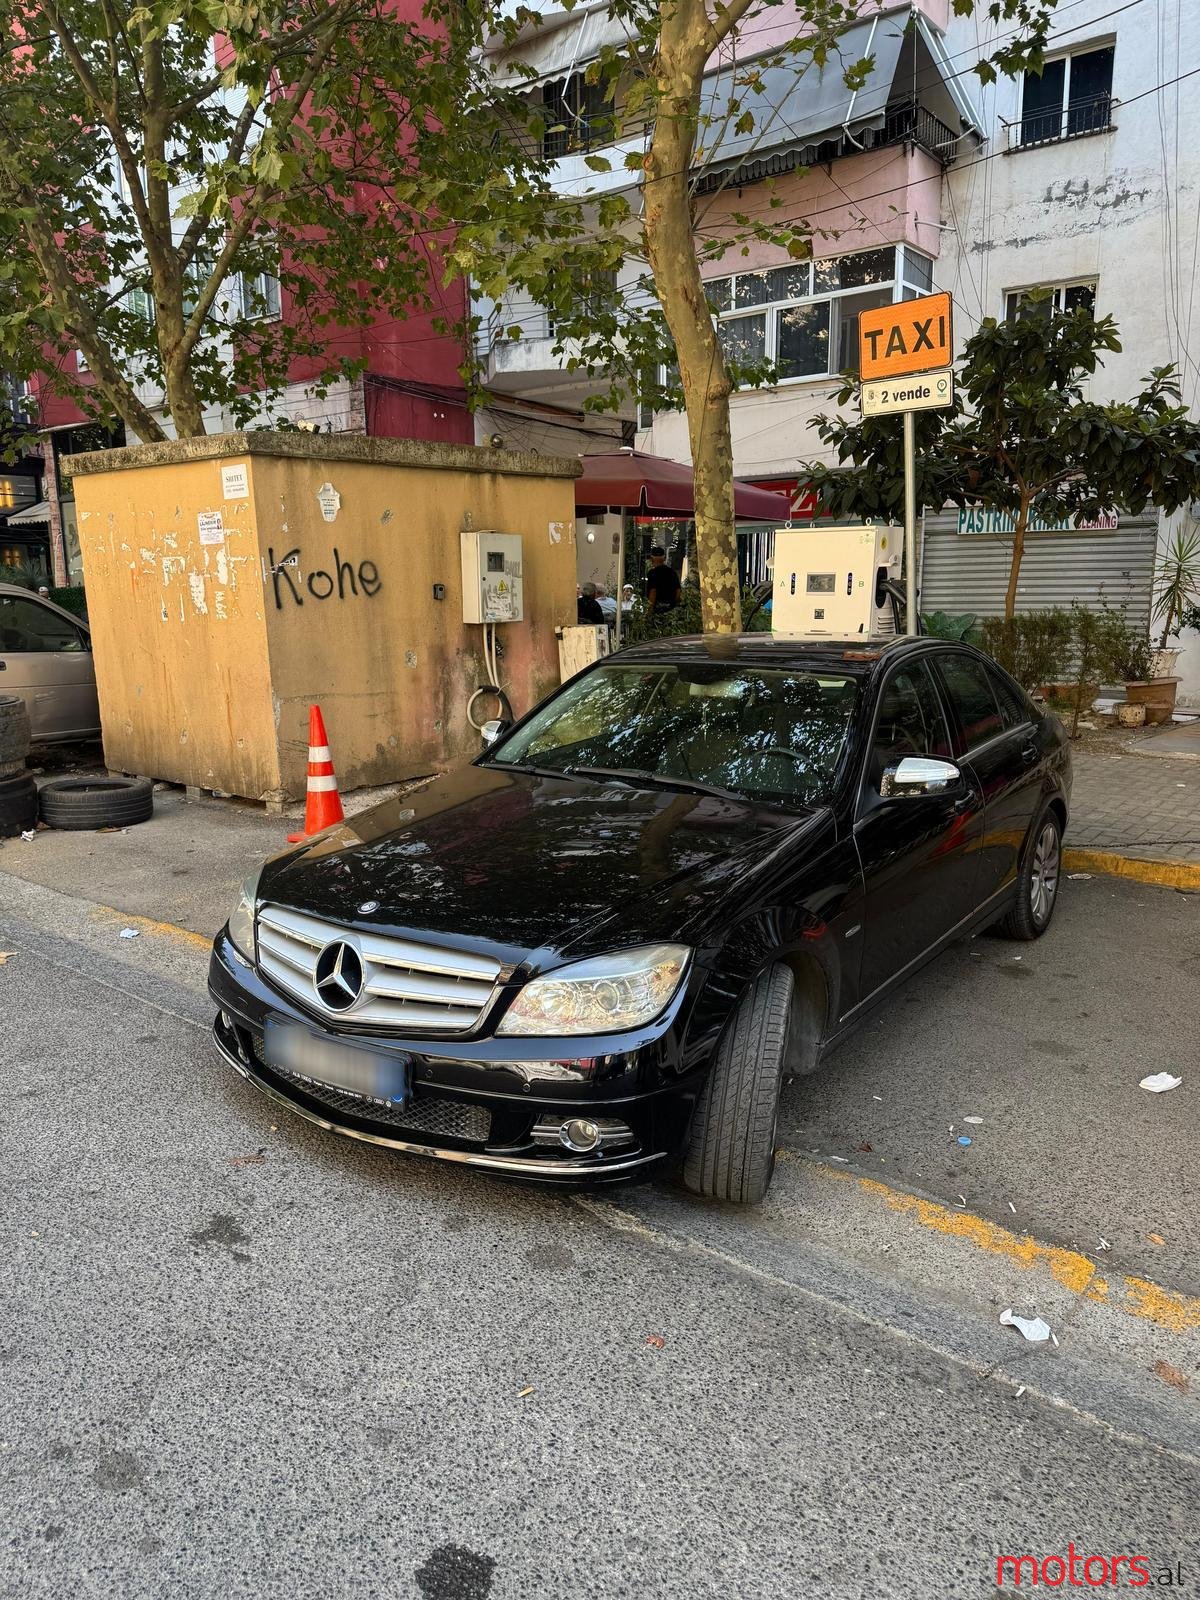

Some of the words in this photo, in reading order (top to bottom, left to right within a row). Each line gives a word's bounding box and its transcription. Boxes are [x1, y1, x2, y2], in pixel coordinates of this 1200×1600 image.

[864, 316, 945, 360] TAXI
[881, 390, 889, 404] 2
[893, 386, 931, 402] vende
[268, 548, 381, 609] Kohe
[780, 580, 786, 588] A
[858, 580, 865, 588] B
